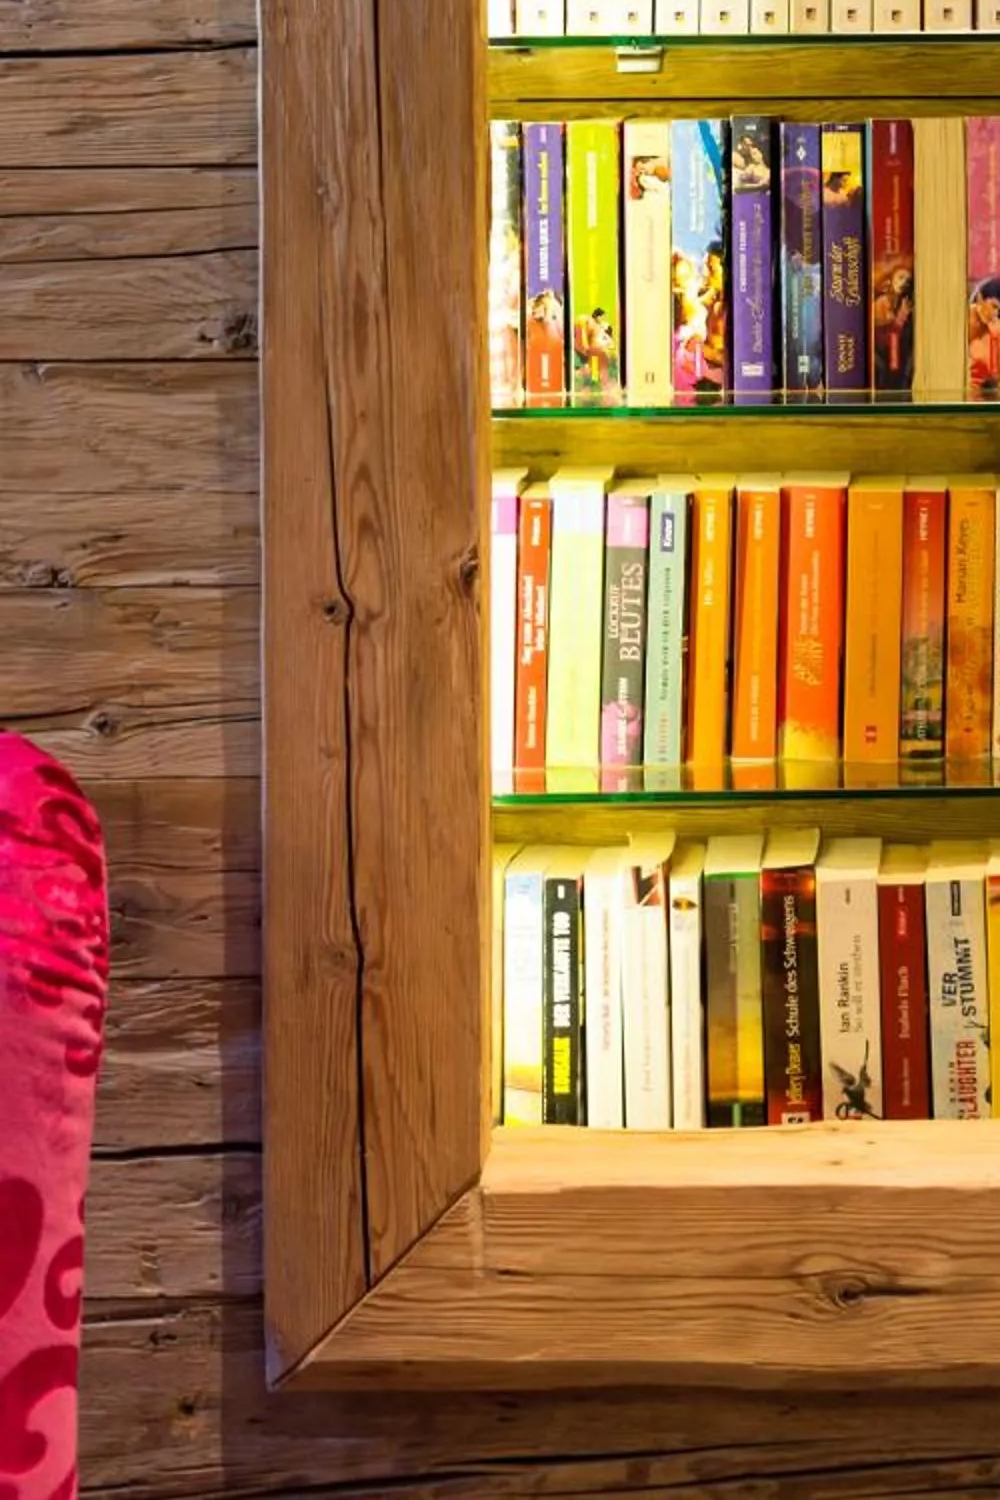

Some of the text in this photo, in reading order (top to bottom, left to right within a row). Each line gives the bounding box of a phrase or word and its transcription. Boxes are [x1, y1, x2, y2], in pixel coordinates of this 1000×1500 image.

[955, 518, 971, 604] Marian Keyes
[608, 583, 620, 639] LOCKRUF
[619, 563, 643, 662] BLUTES
[783, 895, 800, 968] Schweigens
[783, 969, 797, 993] des
[837, 962, 850, 1033] Ian Rankin
[941, 973, 958, 1007] VER
[953, 937, 976, 1017] STUMMT
[784, 996, 800, 1037] Schule
